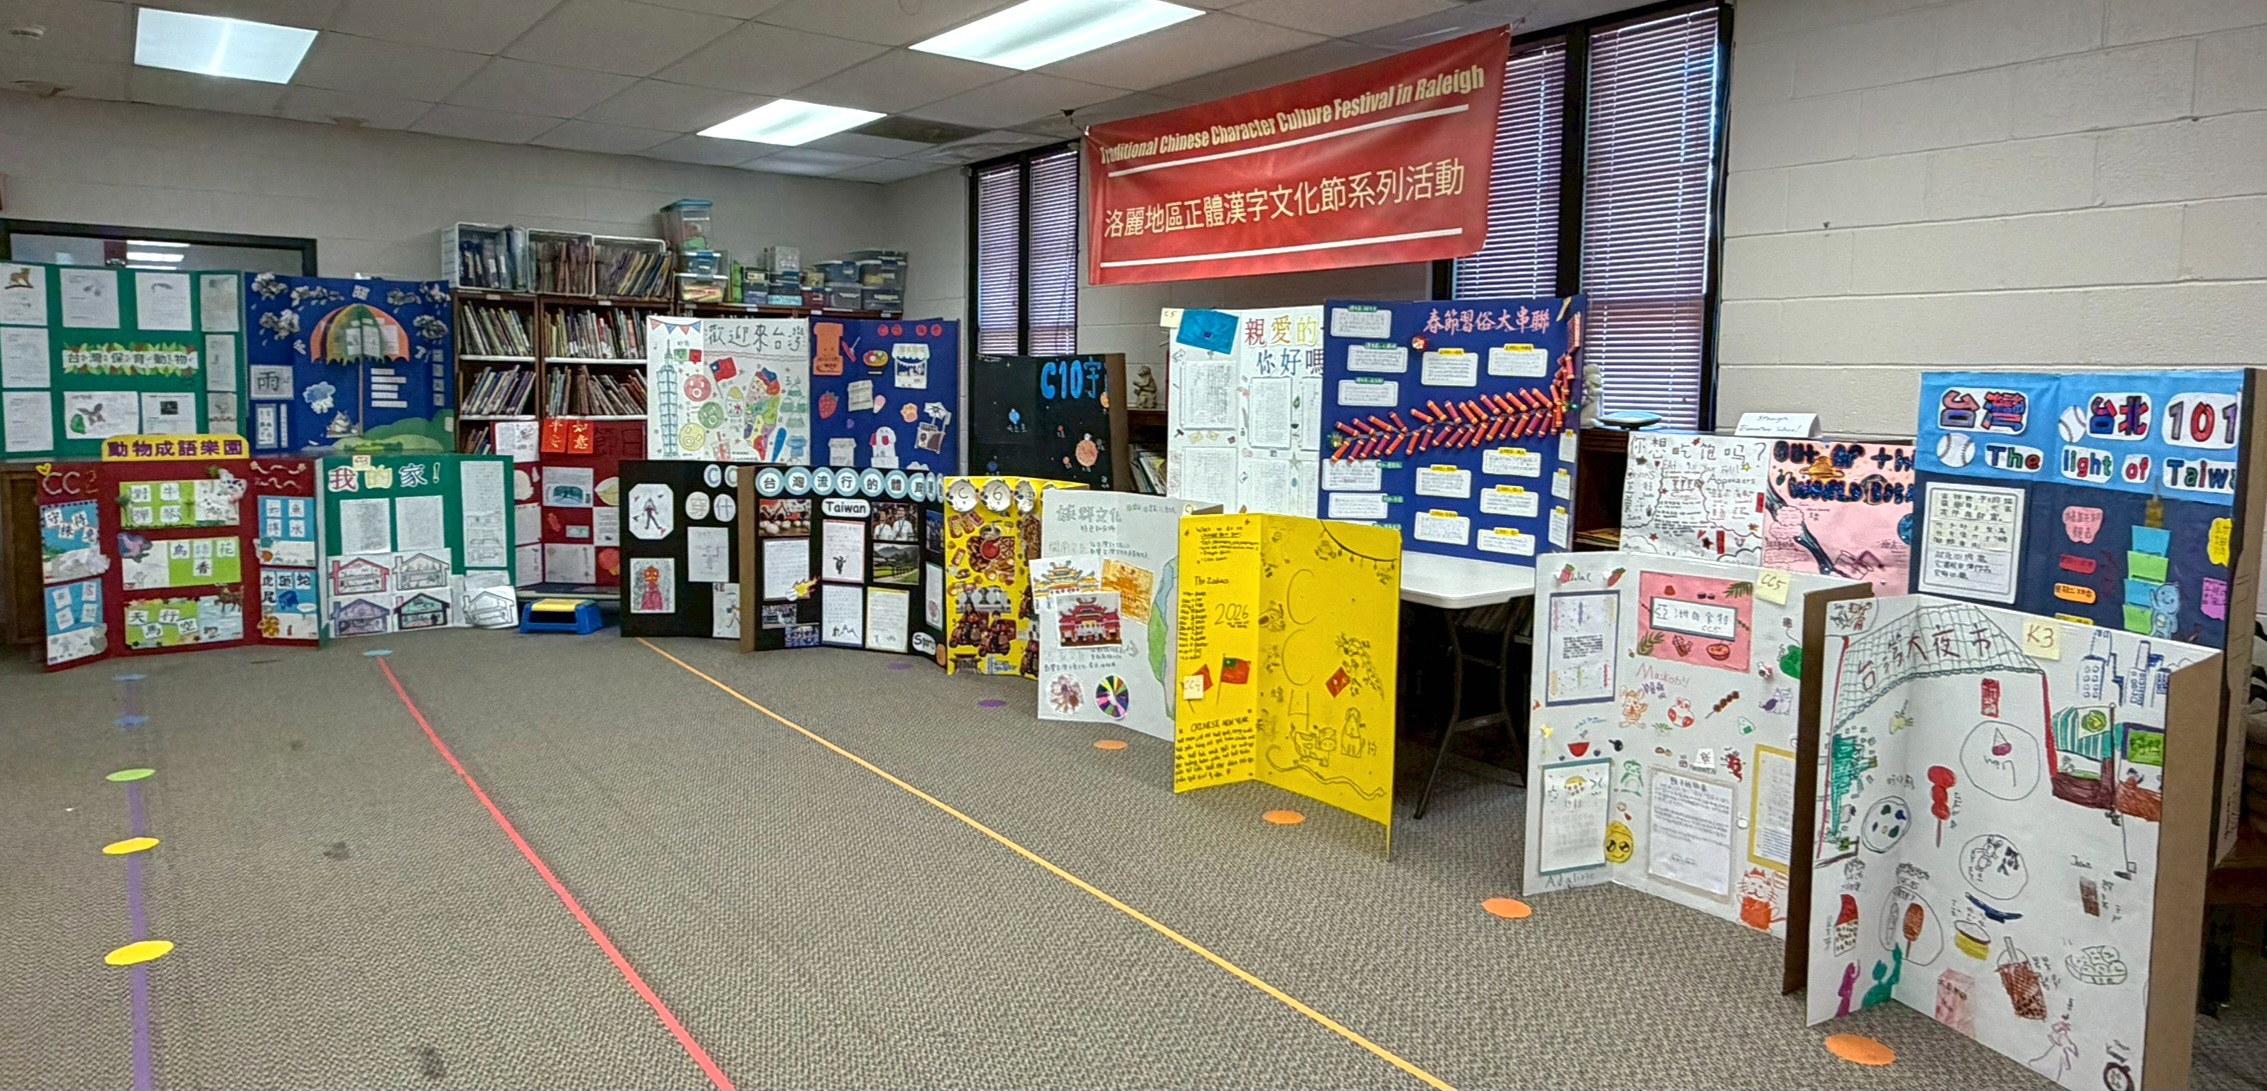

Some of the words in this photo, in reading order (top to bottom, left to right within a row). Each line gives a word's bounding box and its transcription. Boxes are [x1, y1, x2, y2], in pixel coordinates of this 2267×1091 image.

[1100, 137, 1159, 165] Traditional
[1159, 129, 1209, 155] Chinese
[1211, 117, 1276, 147] Character
[1276, 103, 1332, 132] Culture
[1334, 86, 1394, 119] Festival
[1396, 82, 1412, 105] in
[1414, 64, 1485, 101] Raleigh
[1104, 158, 1465, 238] 洛麗地區正體漢字文化節系列活動
[708, 324, 804, 352] 歡迎來台灣
[1244, 315, 1319, 346] 親愛的
[257, 370, 280, 392] 雨
[1939, 389, 2027, 432] 台灣
[2087, 395, 2149, 437] 台北
[2168, 400, 2238, 444] 101
[107, 440, 243, 457] 動物成語樂園
[1986, 445, 2041, 470] The
[2063, 447, 2113, 479] light
[2125, 455, 2150, 481] of
[826, 501, 867, 514] Taiwan
[1214, 603, 1249, 625] 2026
[2026, 624, 2055, 648] K3
